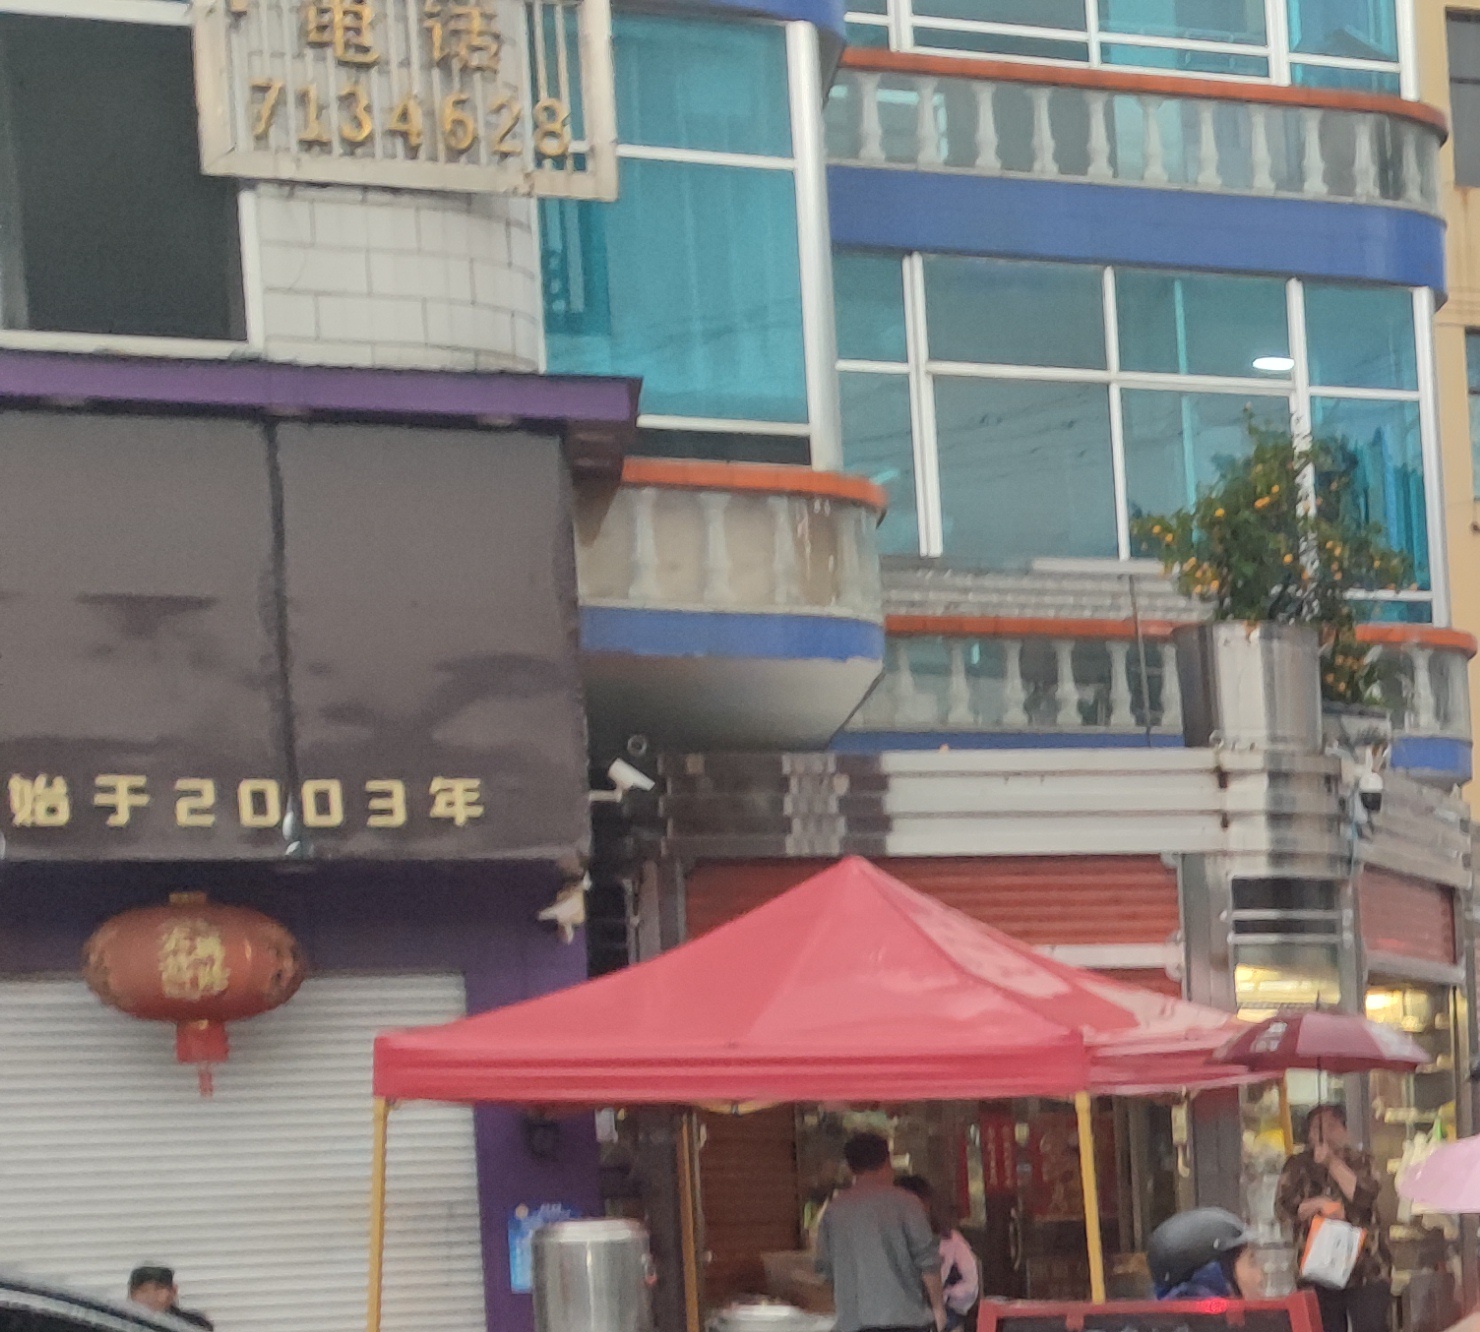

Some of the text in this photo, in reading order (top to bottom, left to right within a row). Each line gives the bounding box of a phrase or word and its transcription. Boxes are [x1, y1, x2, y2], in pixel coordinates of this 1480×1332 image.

[306, 0, 501, 71] 电话
[249, 78, 572, 157] 7134628
[8, 773, 485, 828] 始于2003年
